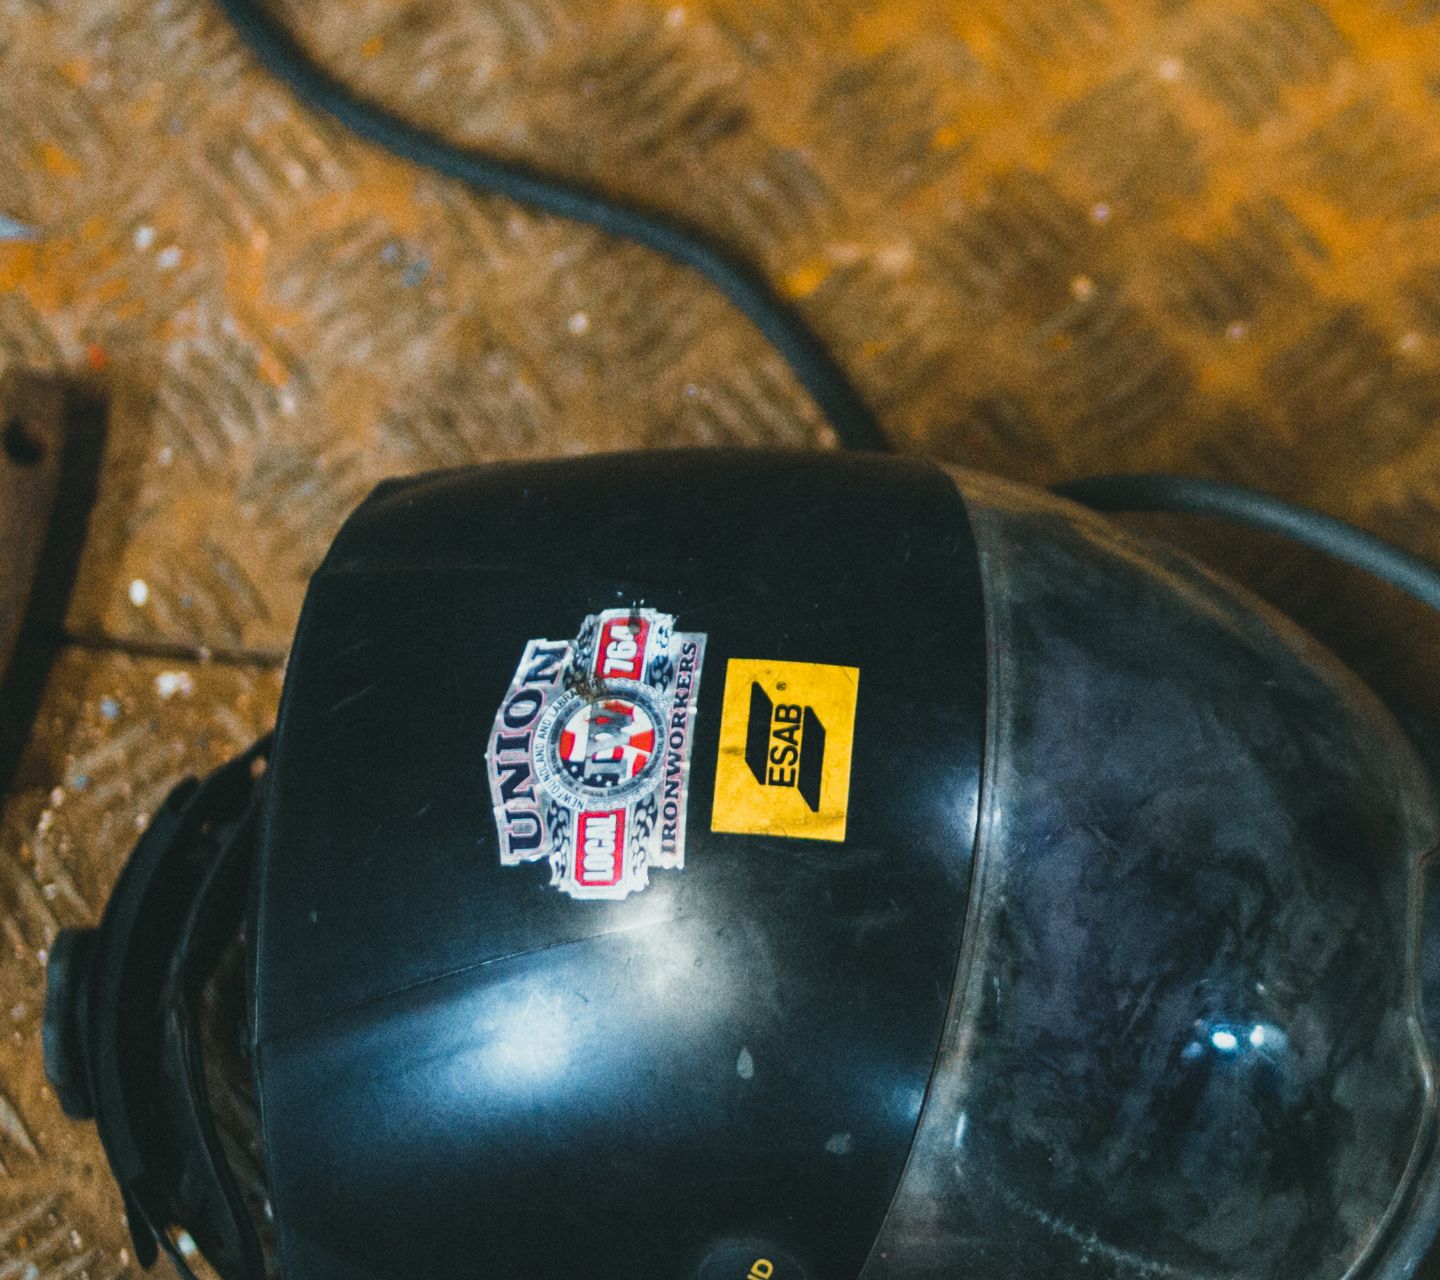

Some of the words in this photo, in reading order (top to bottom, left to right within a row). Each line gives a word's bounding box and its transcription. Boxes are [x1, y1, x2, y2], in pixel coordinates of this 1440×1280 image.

[604, 624, 638, 674] 764
[496, 646, 571, 854] UNION
[537, 719, 552, 739] AND
[661, 641, 696, 854] IRONWORKERS
[768, 703, 803, 788] ESAB
[582, 812, 617, 882] LOCAL
